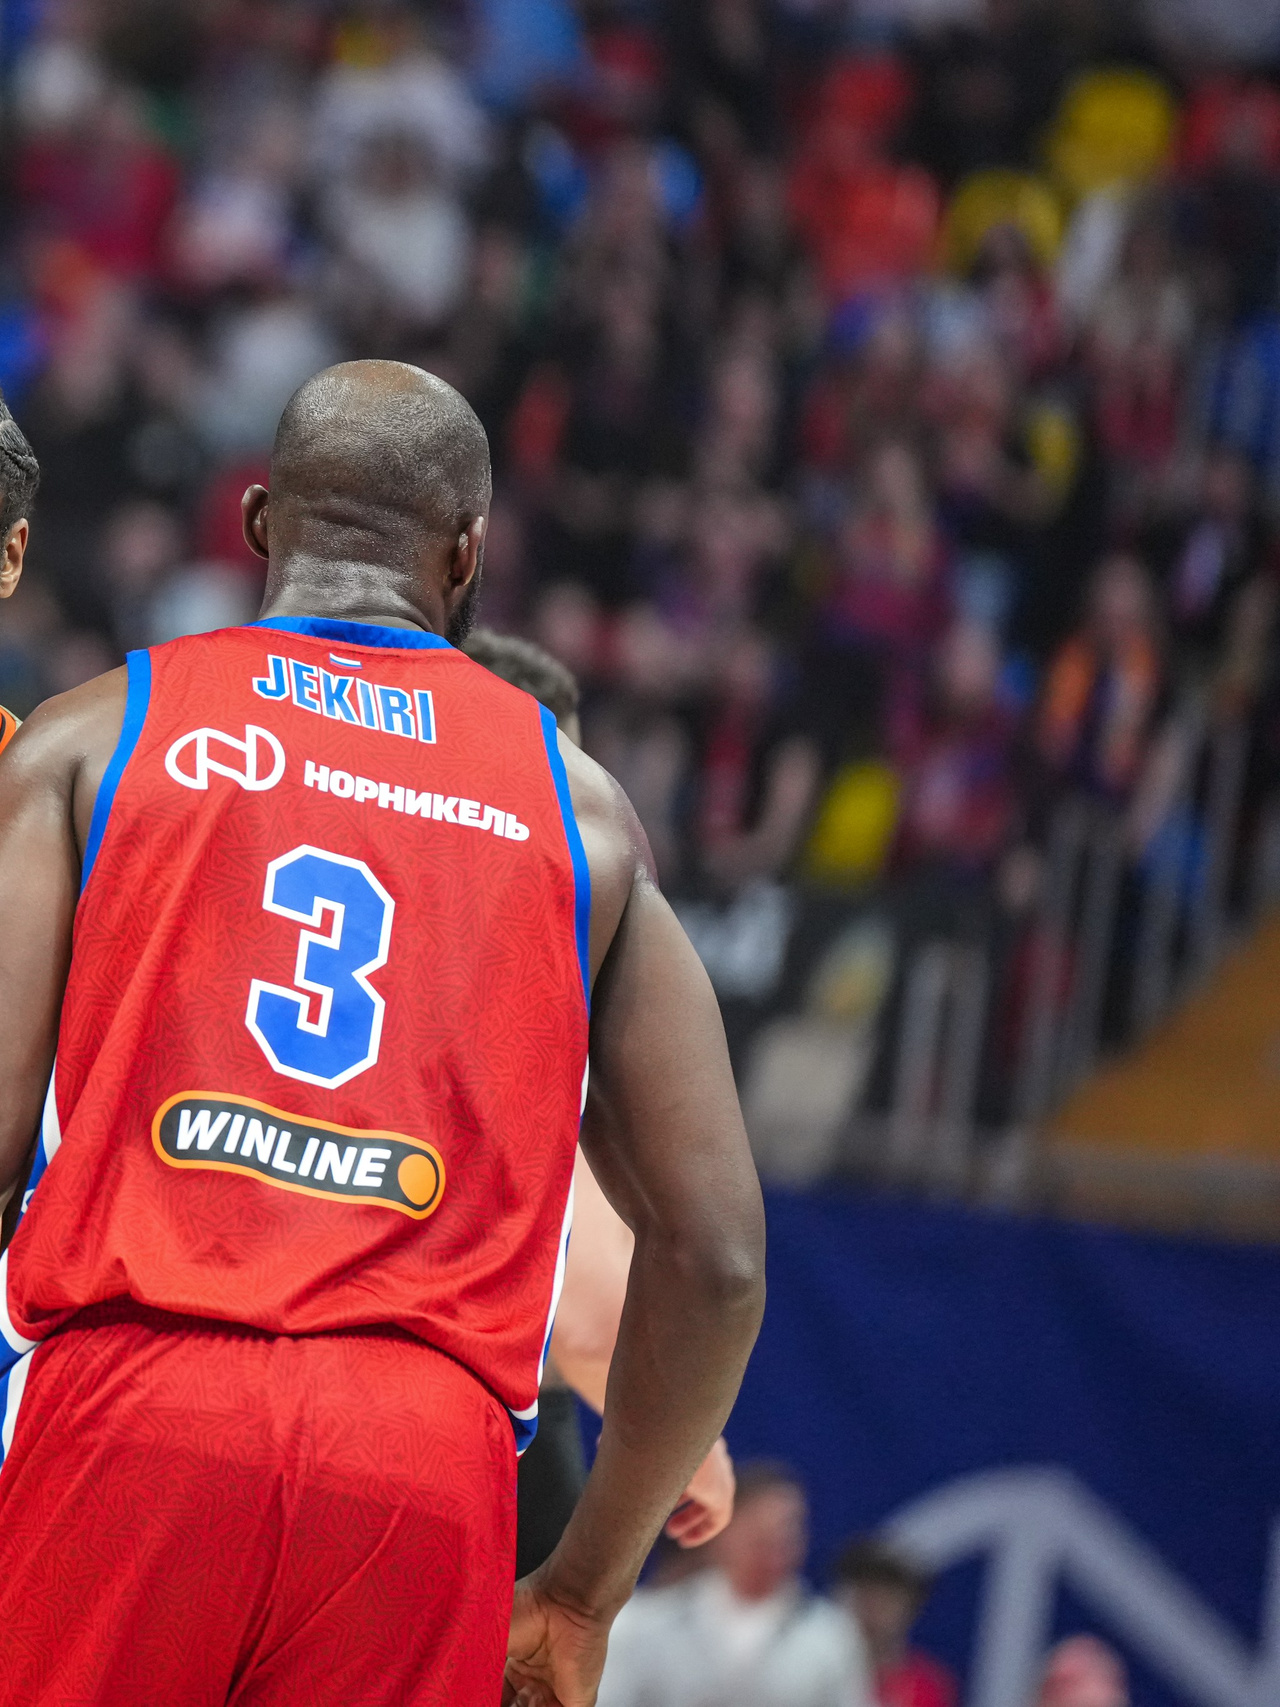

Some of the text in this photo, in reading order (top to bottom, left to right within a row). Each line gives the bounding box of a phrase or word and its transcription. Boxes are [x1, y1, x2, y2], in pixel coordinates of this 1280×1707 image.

[252, 654, 437, 744] JEKIRI
[303, 759, 530, 842] НОРНИКЕЛЬ
[244, 844, 396, 1090] 3
[176, 1108, 392, 1188] WINLINE
